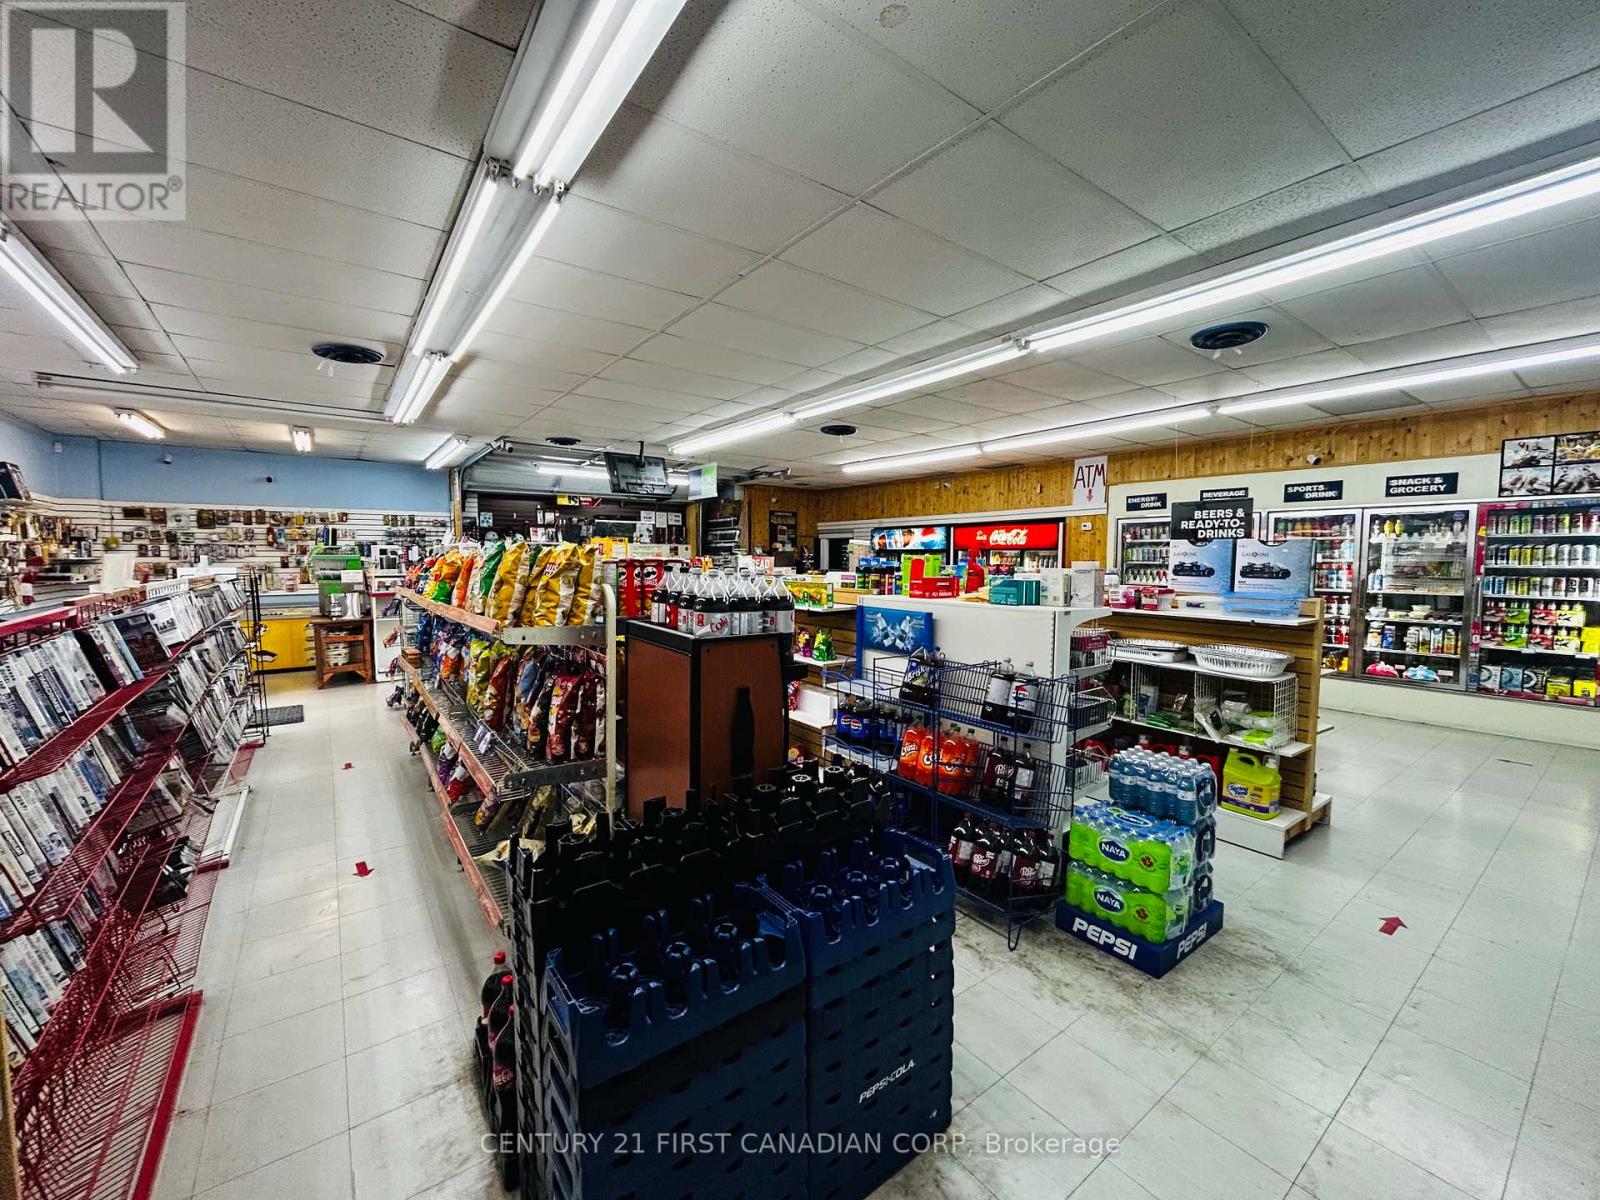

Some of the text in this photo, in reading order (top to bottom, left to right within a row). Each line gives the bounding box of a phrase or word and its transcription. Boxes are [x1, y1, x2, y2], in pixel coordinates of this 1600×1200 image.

[1074, 463, 1107, 489] ATM
[1389, 476, 1443, 486] SNACK &
[1202, 490, 1246, 498] BEVERAGE
[1287, 484, 1325, 493] SPORTS
[1305, 490, 1337, 499] DRINK
[1390, 484, 1447, 494] GROCERY
[1127, 496, 1156, 504] ENERGY
[1140, 501, 1162, 509] DRINK
[1193, 508, 1245, 520] BEERS &
[1180, 518, 1245, 530] READY-TO-
[1197, 528, 1245, 539] DRINKS
[709, 616, 729, 634] Coke
[901, 743, 918, 756] Crush
[1101, 842, 1126, 859] NAYA
[1096, 893, 1121, 911] NAYA
[1072, 918, 1138, 960] PEPSI
[1177, 923, 1207, 959] PEPSI
[859, 1059, 916, 1104] PEPSI-COLA
